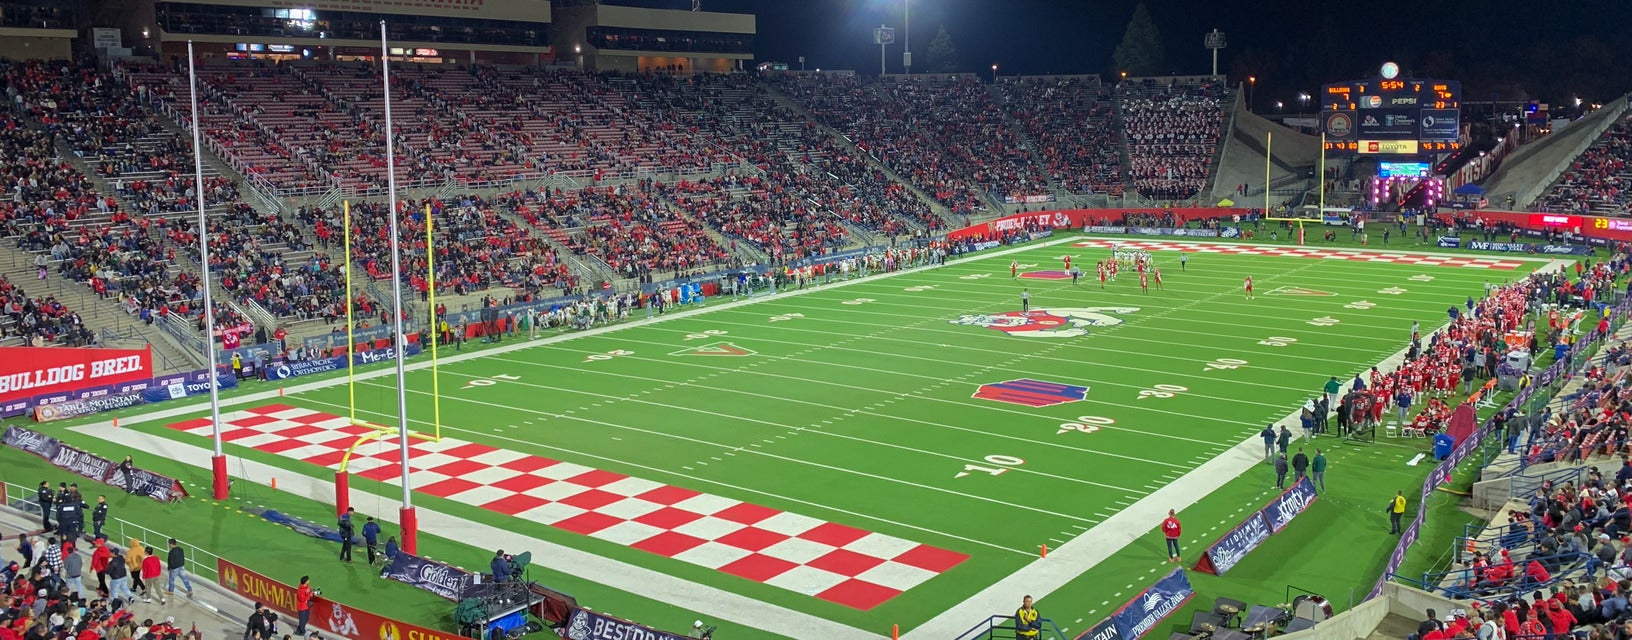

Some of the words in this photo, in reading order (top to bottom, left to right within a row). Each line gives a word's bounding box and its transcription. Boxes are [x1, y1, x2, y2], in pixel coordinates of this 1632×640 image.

[1381, 81, 1404, 89] 5:54
[1595, 218, 1608, 229] 23
[0, 364, 84, 394] BULLDOG
[90, 355, 143, 378] BRED.
[293, 363, 337, 376] ORTHOPEDICS
[187, 380, 222, 392] TOYOA
[1139, 384, 1188, 398] 30
[57, 402, 88, 413] TABLE
[89, 393, 142, 408] MOUNTAIN
[1059, 416, 1116, 433] 20
[964, 455, 1027, 476] 10
[420, 564, 459, 591] Golden
[243, 573, 298, 612] SUN-MAI
[1153, 601, 1172, 620] VALLEY
